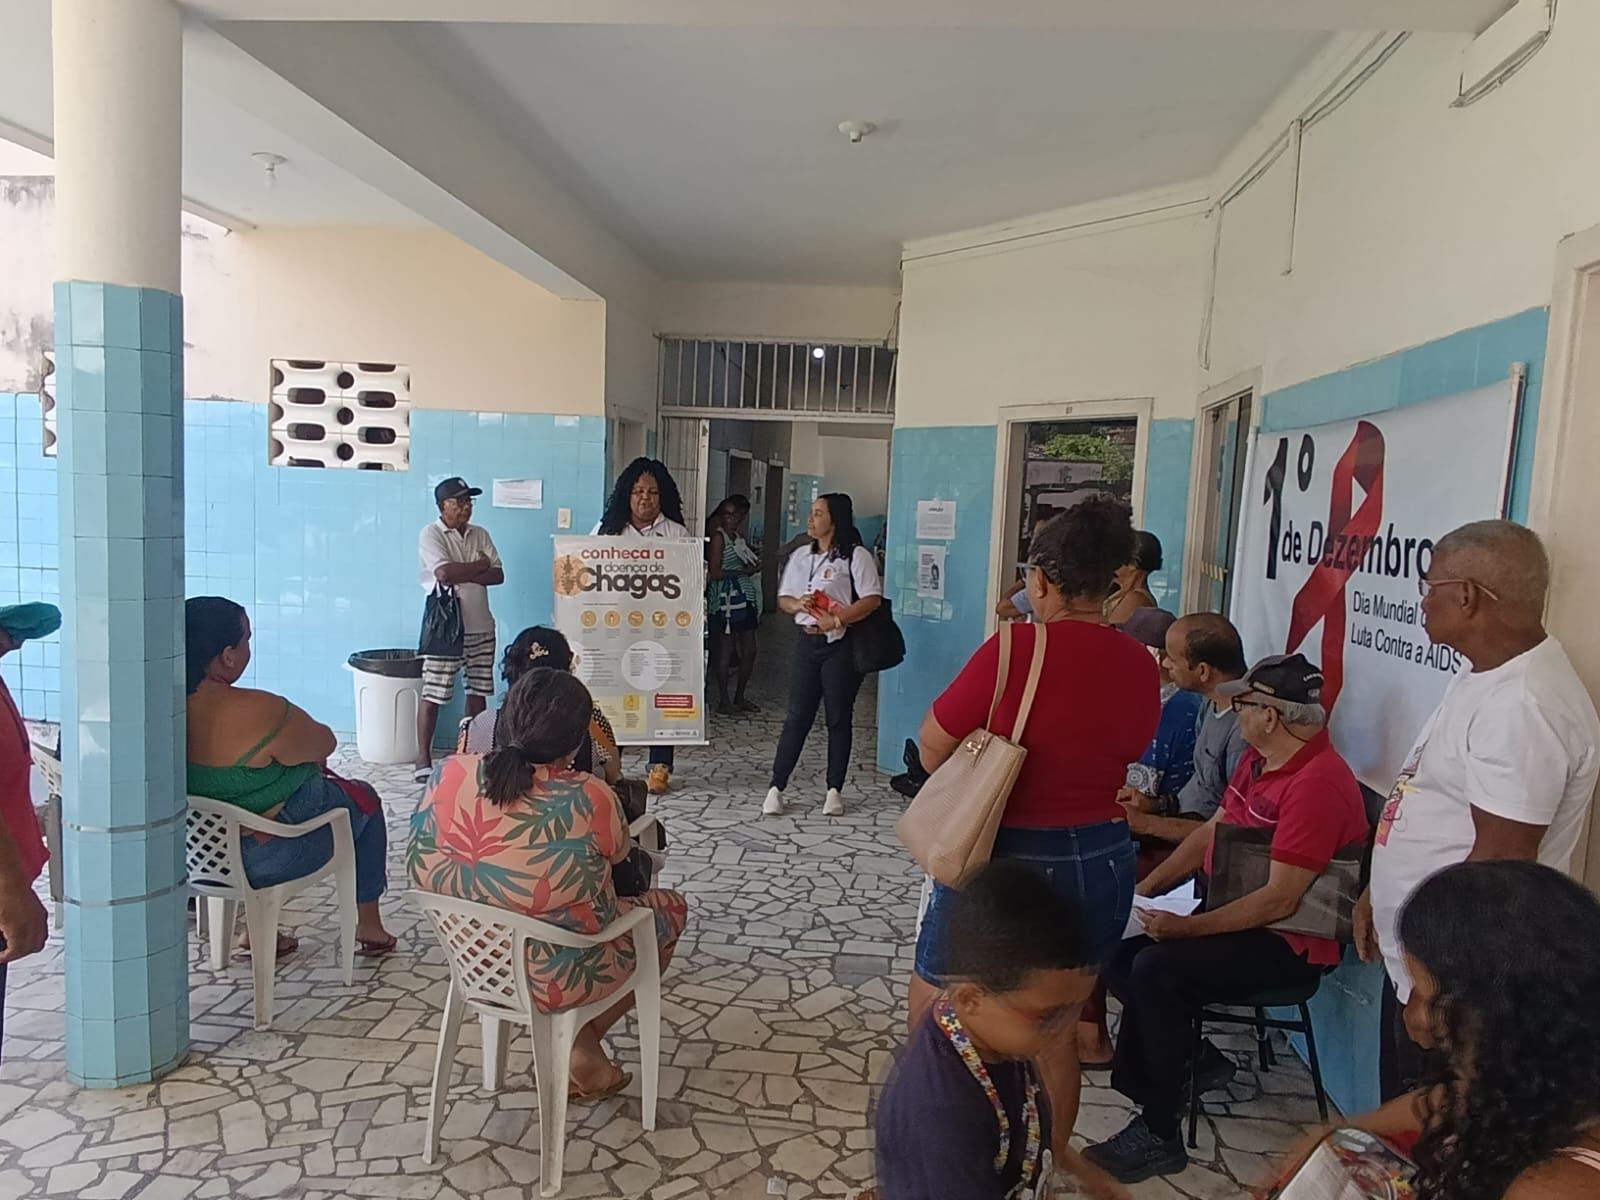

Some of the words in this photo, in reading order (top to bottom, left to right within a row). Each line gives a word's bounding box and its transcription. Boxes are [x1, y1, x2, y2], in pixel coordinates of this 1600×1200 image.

[655, 550, 664, 559] a
[1282, 519, 1302, 564] de
[1307, 520, 1434, 580] Dezembro
[577, 565, 681, 599] Chagas
[604, 562, 648, 574] doença
[650, 562, 664, 573] de
[1353, 590, 1371, 615] Dia
[1373, 594, 1418, 625] Mundial
[1351, 622, 1373, 649] Luta
[1375, 628, 1414, 661] Contra
[1414, 644, 1424, 664] a
[1424, 643, 1462, 674] AIDS
